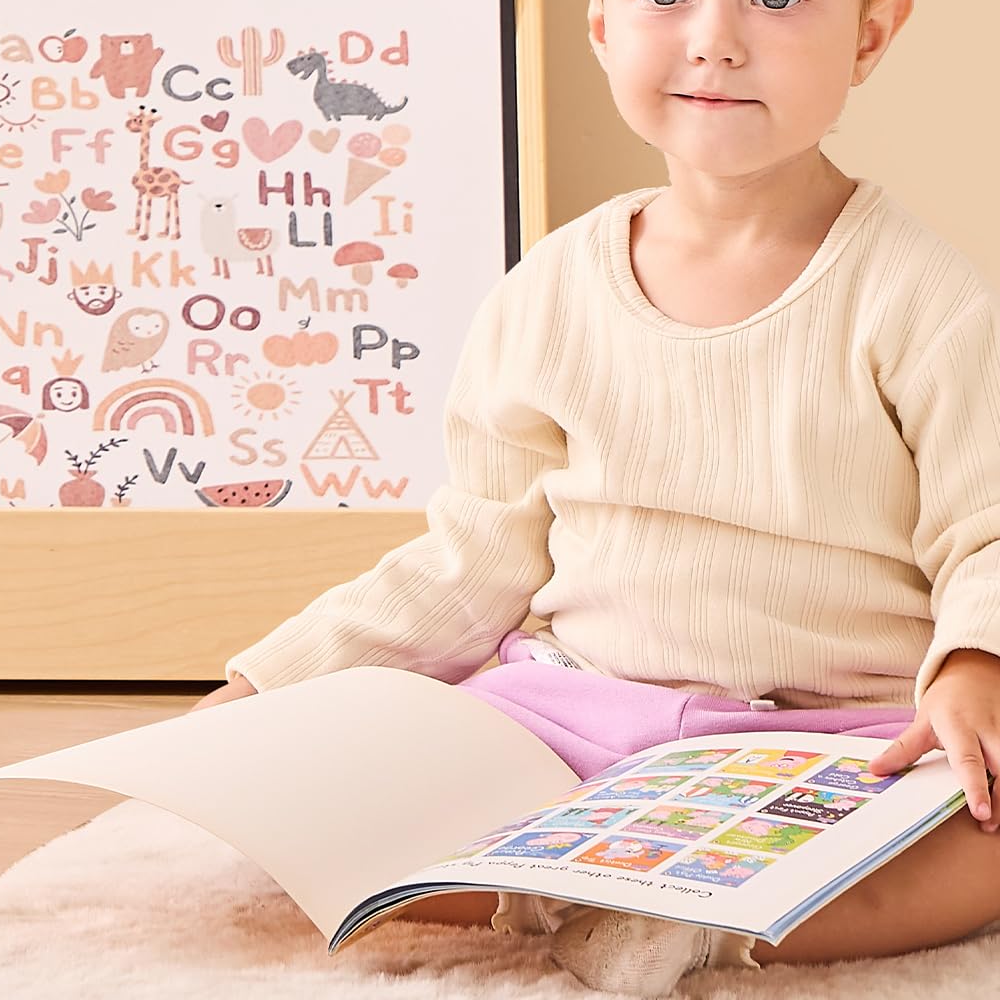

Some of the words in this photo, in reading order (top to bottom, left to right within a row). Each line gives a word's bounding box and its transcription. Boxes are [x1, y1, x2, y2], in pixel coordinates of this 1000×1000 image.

[339, 29, 409, 66] Dd
[30, 75, 101, 111] Bb
[162, 64, 235, 101] Cc
[51, 127, 114, 164] Ff
[163, 124, 240, 168] Gg
[259, 170, 331, 207] Hh
[16, 238, 59, 285] Jj
[131, 250, 196, 288] Kk
[181, 293, 261, 331] Oo
[278, 275, 369, 313] Mm
[187, 338, 251, 376] Rr
[353, 323, 420, 369] Pp
[353, 378, 415, 415] Tt
[143, 447, 206, 484] Vv
[228, 427, 288, 468] Ss
[300, 463, 409, 499] Ww
[617, 874, 653, 888] these
[660, 882, 713, 899] Collect
